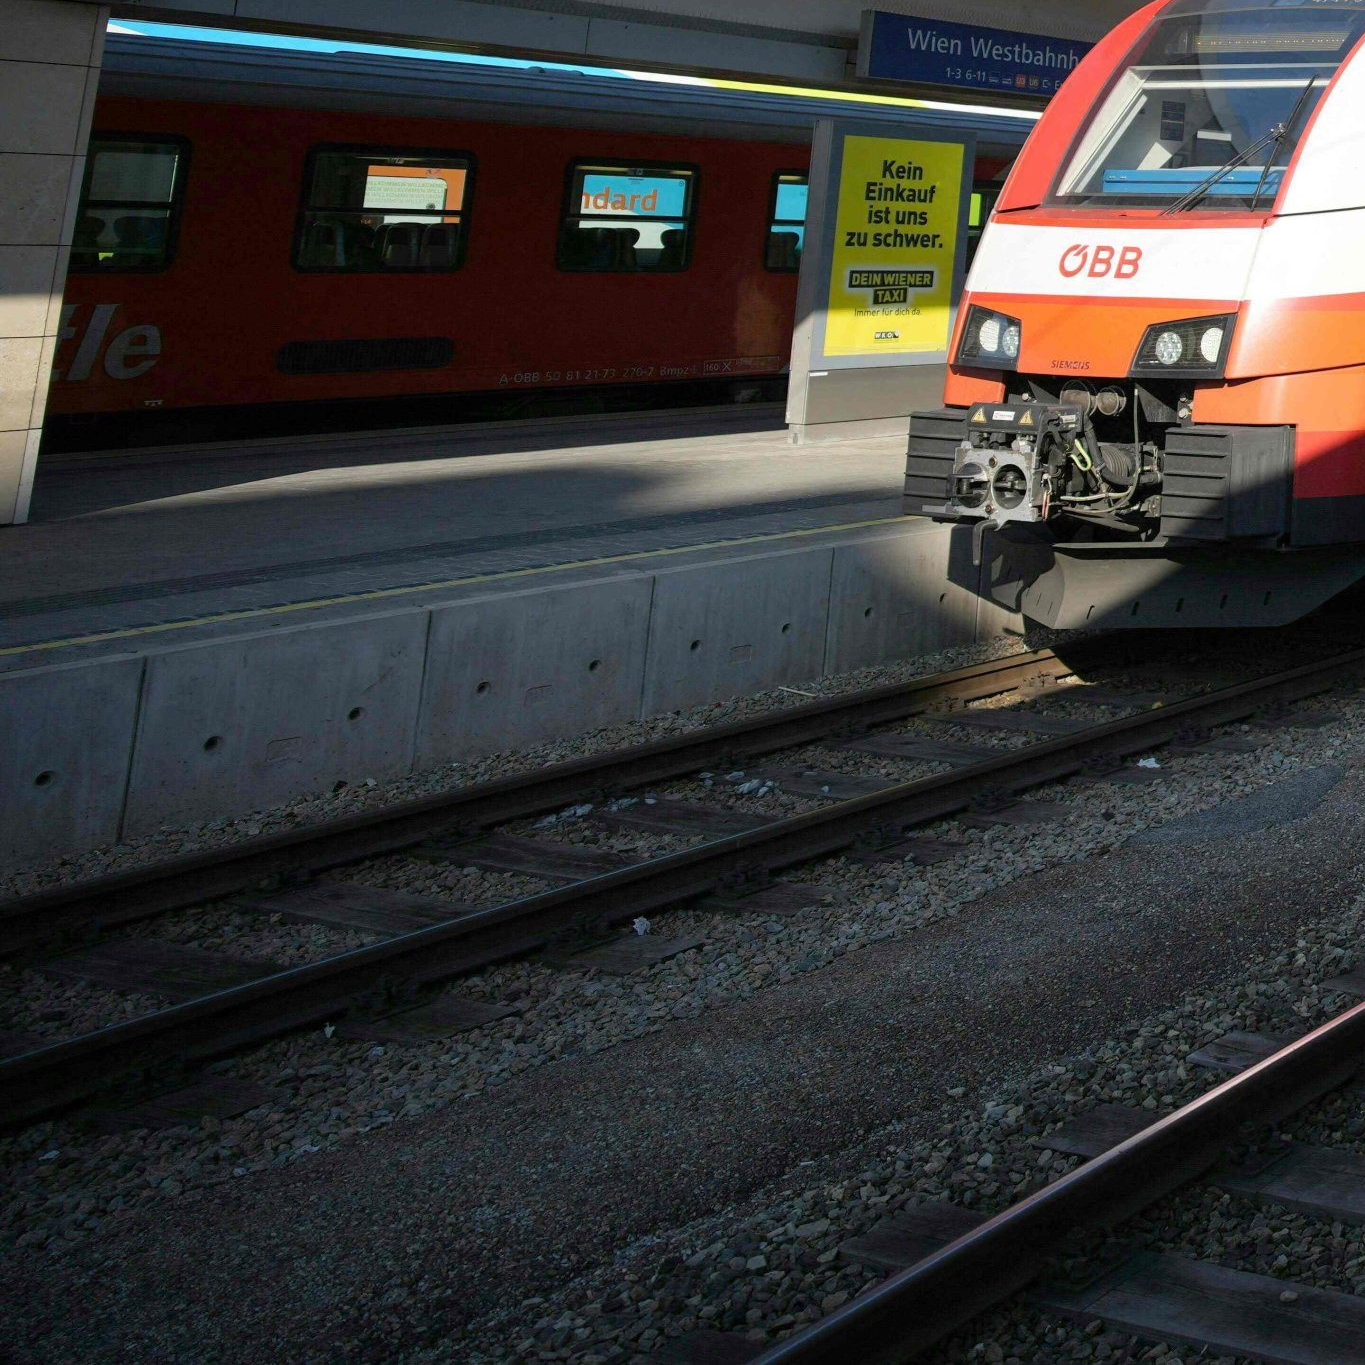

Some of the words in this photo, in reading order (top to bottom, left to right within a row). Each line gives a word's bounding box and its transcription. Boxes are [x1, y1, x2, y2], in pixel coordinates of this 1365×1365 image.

[908, 28, 961, 55] Wien
[969, 36, 1079, 70] Westbahnh
[965, 69, 986, 82] 6-11
[882, 160, 923, 181] Kein
[865, 182, 936, 204] Einkauf
[868, 205, 891, 225] ist
[895, 210, 928, 226] uns
[845, 232, 868, 247] zu
[872, 230, 944, 249] schwer.
[1058, 243, 1143, 279] ÖBB
[852, 273, 884, 286] DEIN
[884, 273, 931, 286] WIENER
[877, 289, 905, 302] TAXI
[855, 308, 880, 317] Immer
[895, 307, 910, 316] dich
[1051, 359, 1090, 370] SIEMENS
